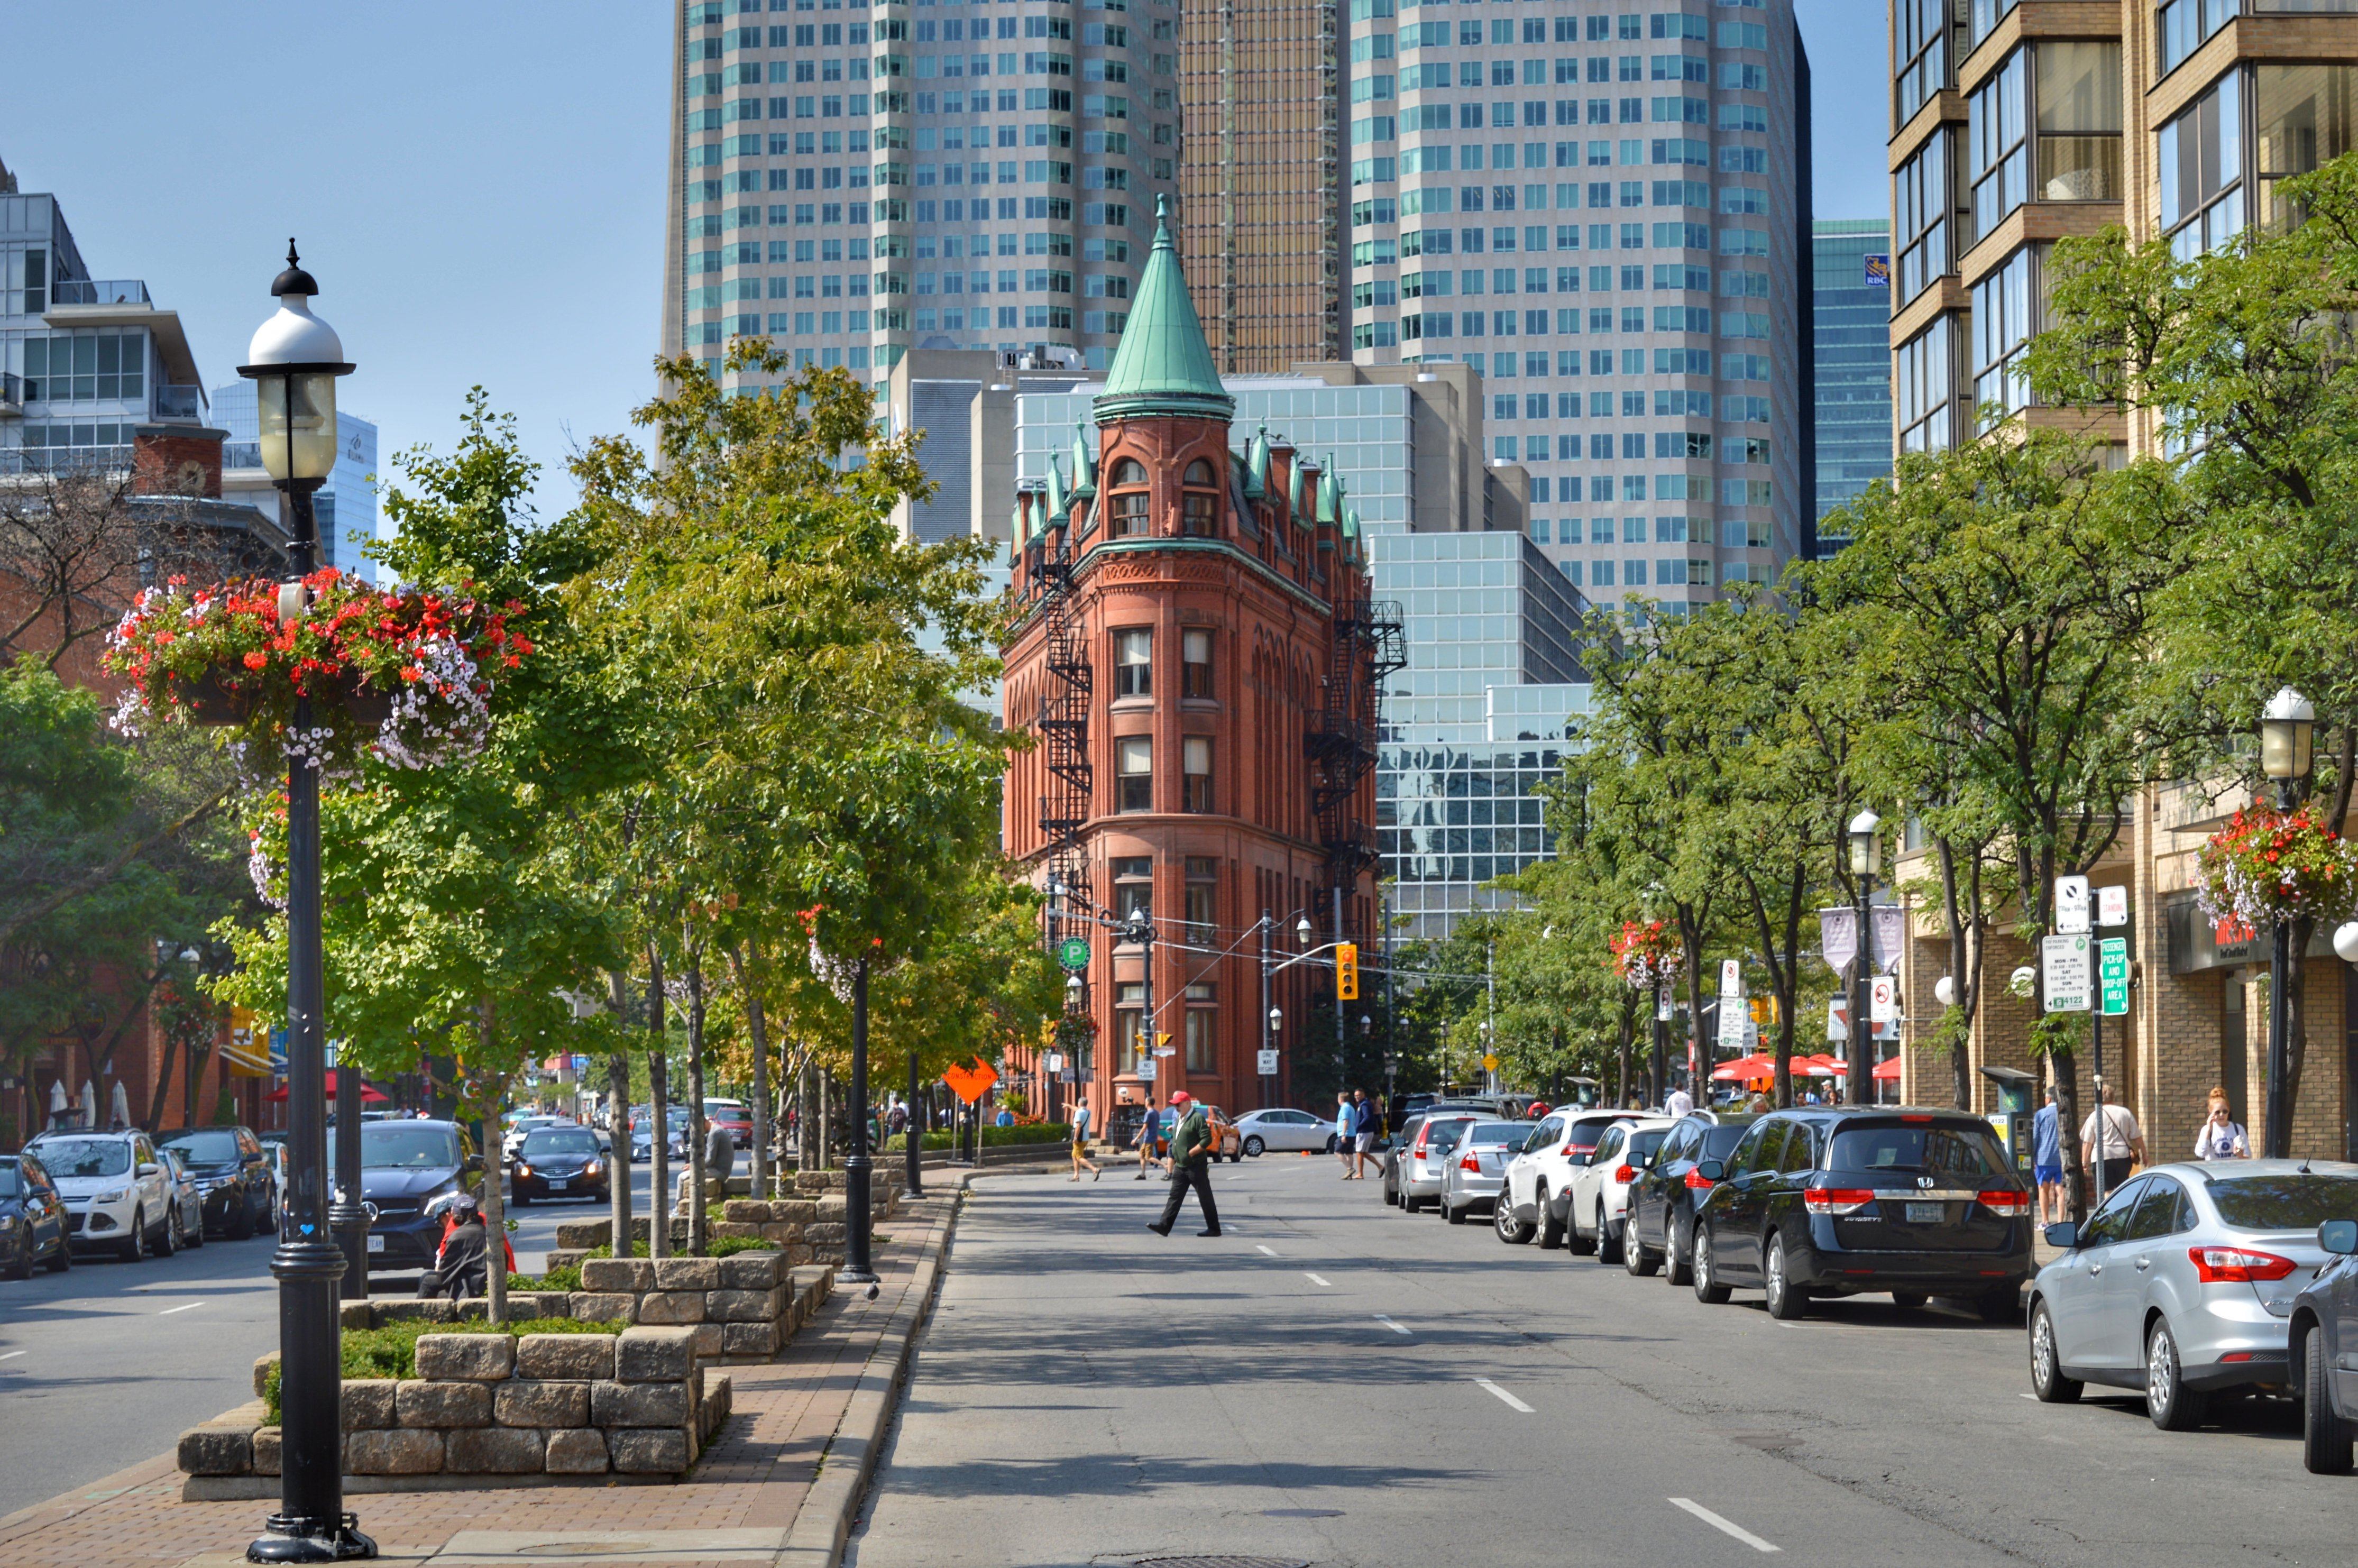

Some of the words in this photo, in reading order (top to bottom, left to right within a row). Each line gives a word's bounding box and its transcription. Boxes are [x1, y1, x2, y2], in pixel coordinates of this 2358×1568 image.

[2103, 903, 2124, 913] STANDING
[2103, 942, 2124, 952] PASSENGER
[1069, 946, 1081, 959] P
[2103, 955, 2124, 964] PICK-UP
[2108, 967, 2120, 976] AND
[2103, 978, 2126, 988] DROP-OFF
[2107, 991, 2123, 1001] AREA
